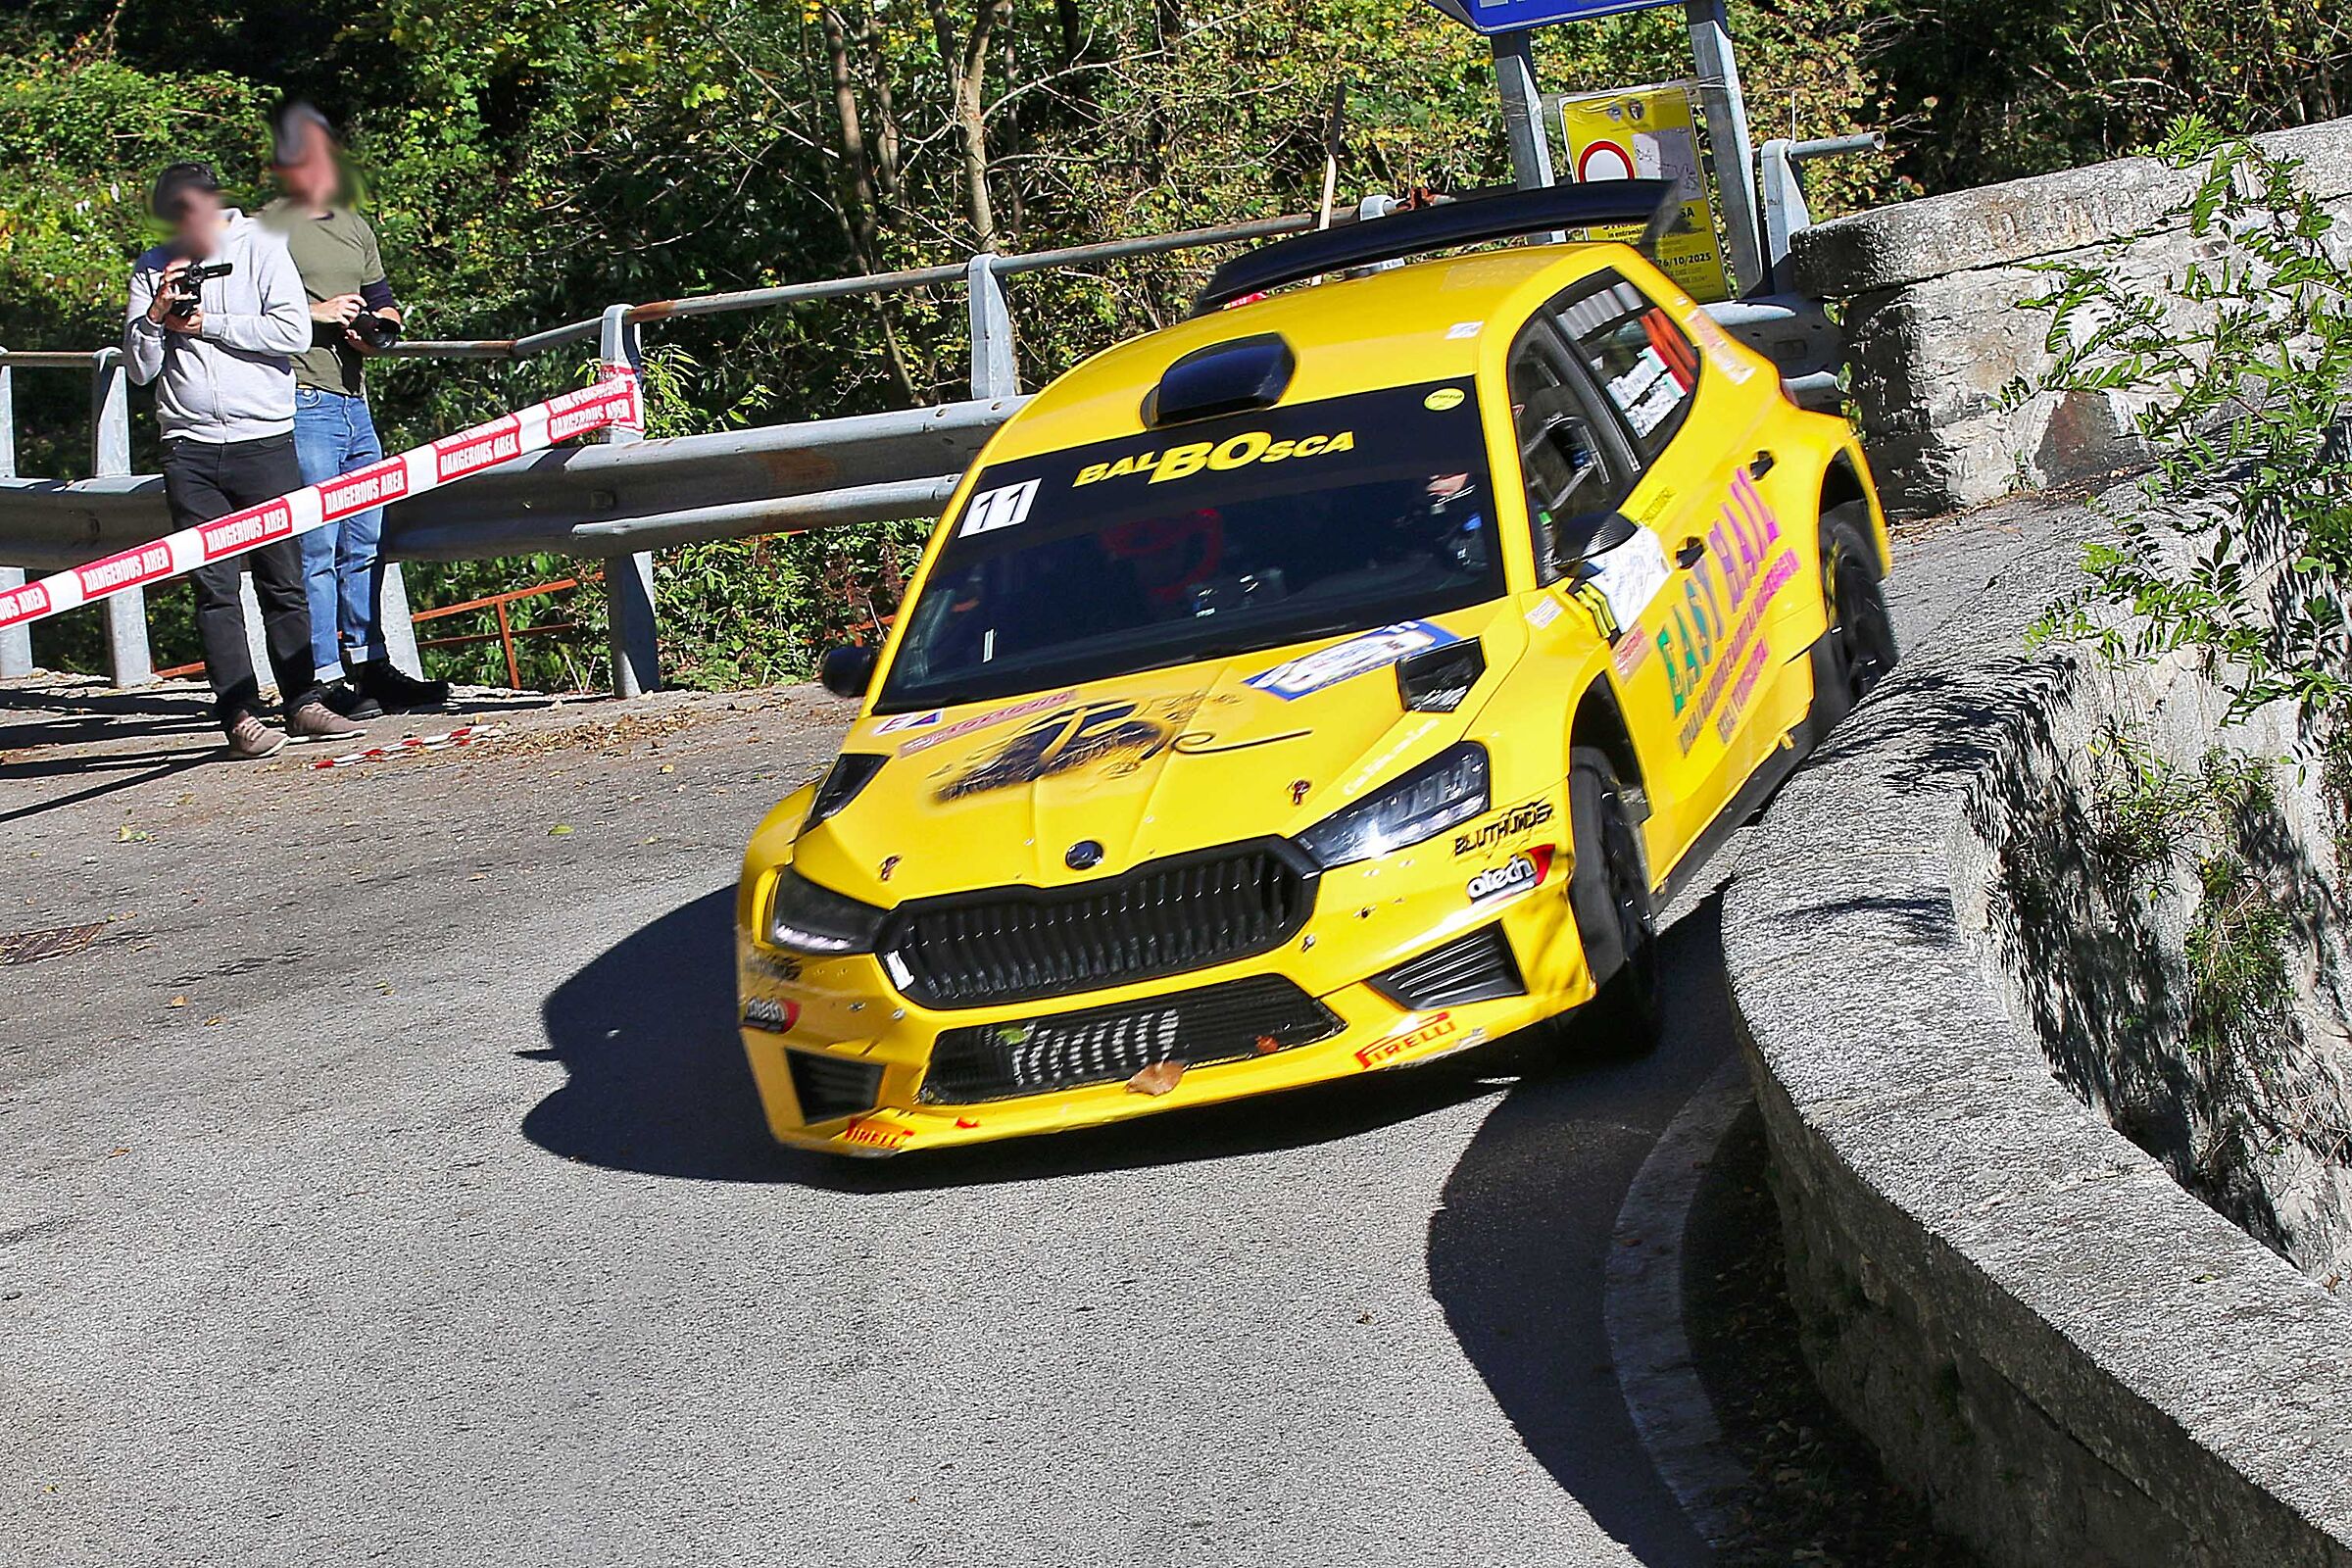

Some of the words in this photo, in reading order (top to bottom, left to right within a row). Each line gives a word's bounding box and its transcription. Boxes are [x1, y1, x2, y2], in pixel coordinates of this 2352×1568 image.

[551, 405, 605, 439] DANGEROUS
[440, 440, 494, 476] DANGEROUS
[492, 432, 518, 457] AREA
[1072, 431, 1354, 488] BALBOSCA
[324, 480, 380, 514] DANGEROUS
[379, 469, 406, 494] AREA
[976, 483, 1028, 530] 11
[205, 515, 264, 553] DANGEROUS
[263, 507, 289, 534] AREA
[81, 555, 143, 593] DANGEROUS
[143, 546, 171, 575] AREA
[1656, 556, 1725, 718] EASY
[1707, 465, 1782, 614] RAIL
[16, 586, 48, 614] AREA
[1355, 1010, 1456, 1069] PIRELLI
[845, 1115, 915, 1151] PIRELLI
